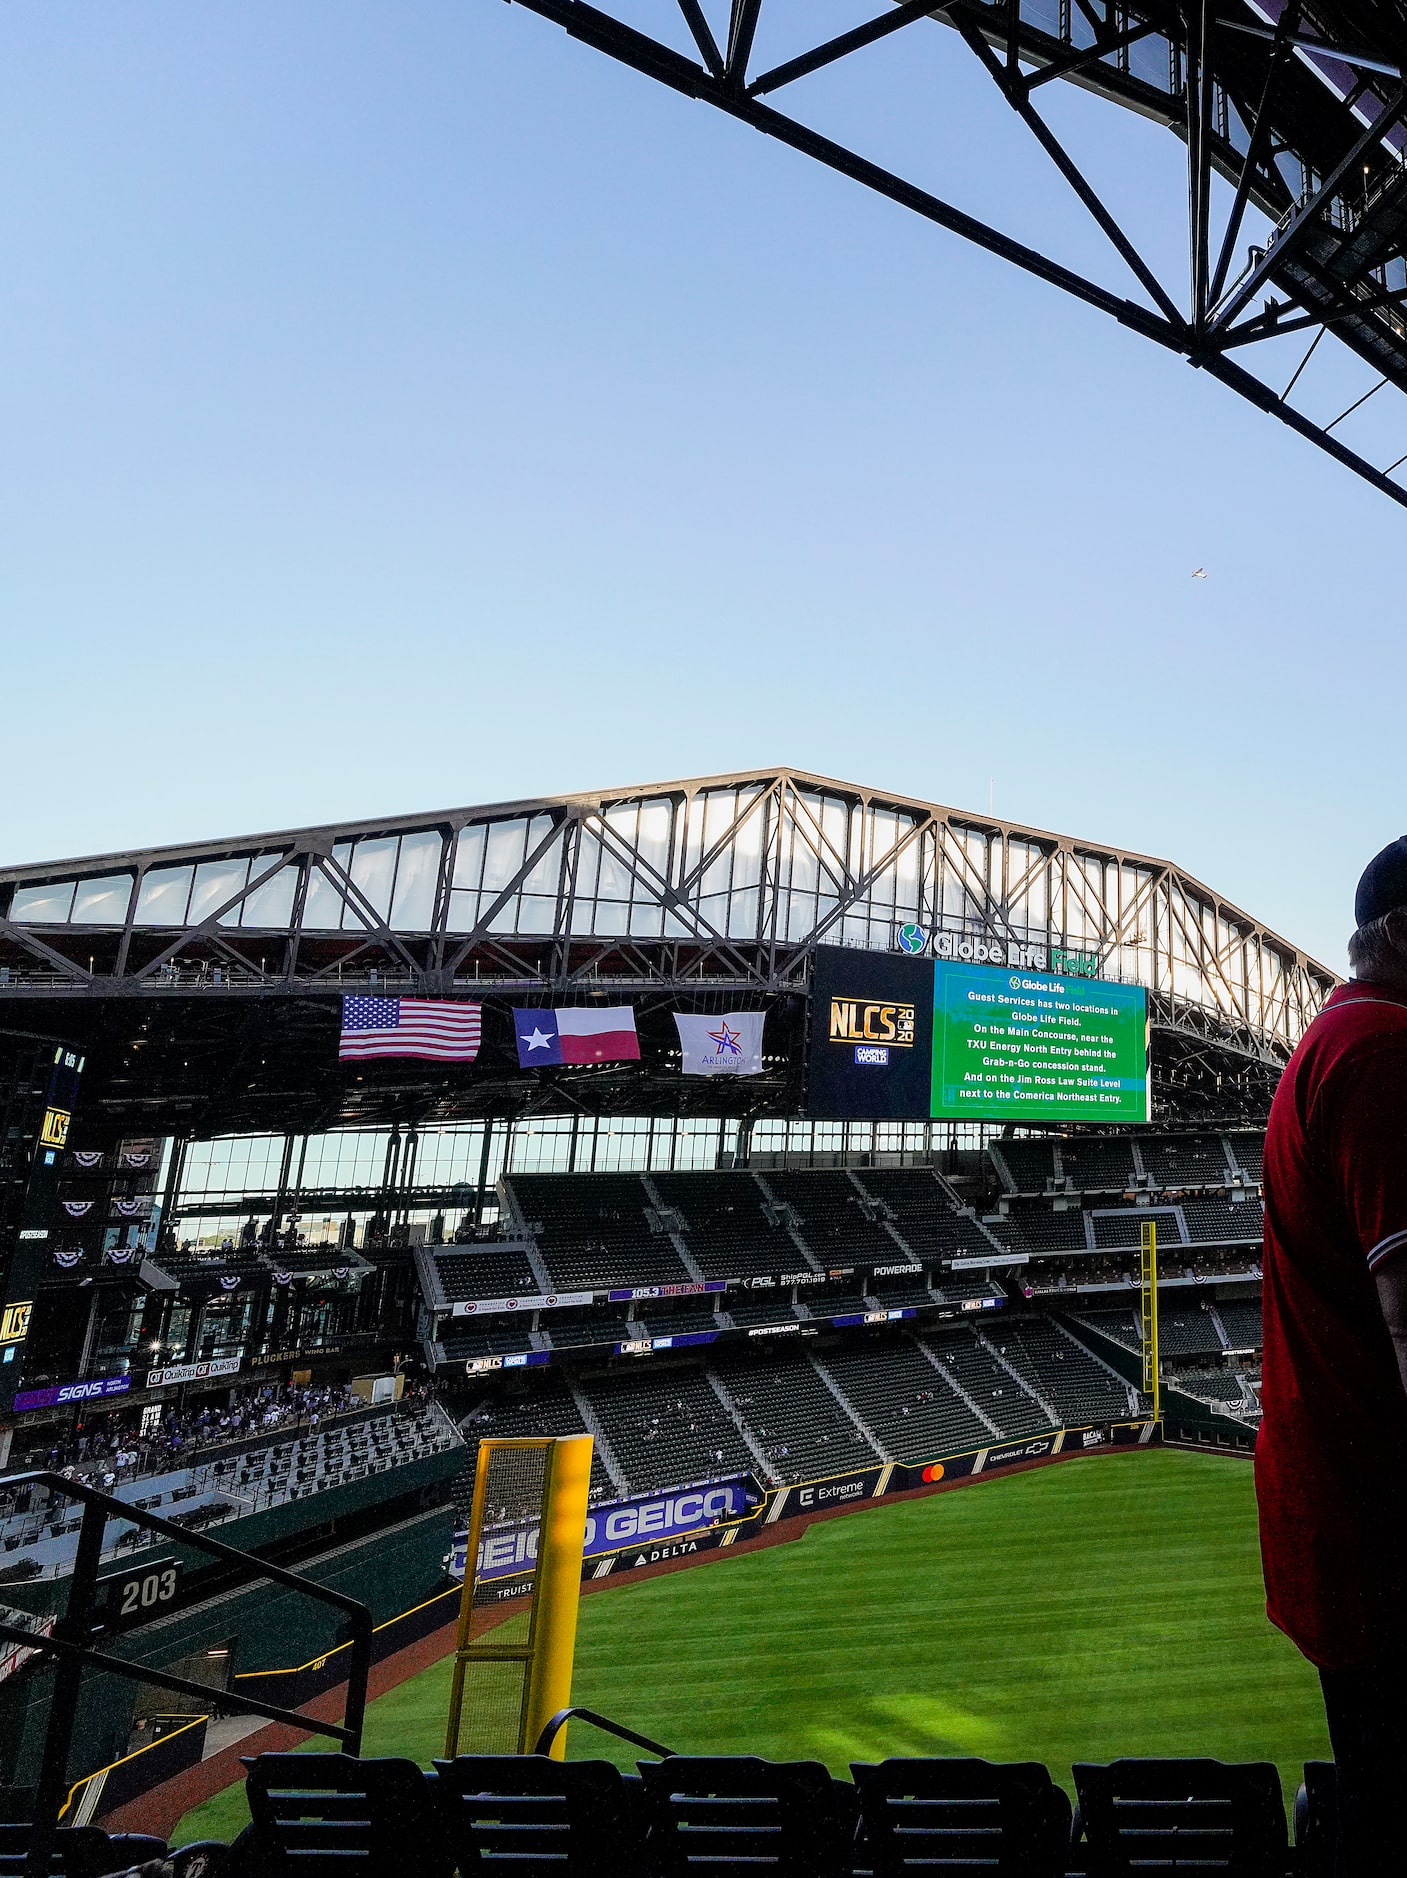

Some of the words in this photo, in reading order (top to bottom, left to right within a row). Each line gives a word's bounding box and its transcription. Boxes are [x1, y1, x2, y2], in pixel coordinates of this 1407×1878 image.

[933, 932, 1002, 963] Globe
[1007, 943, 1047, 969] Life
[1051, 949, 1097, 976] Field
[1022, 979, 1048, 992] Globe
[1049, 982, 1065, 993] Life
[968, 991, 995, 1003] Guest
[997, 994, 1035, 1007] Services
[1037, 999, 1053, 1009] has
[1054, 1001, 1070, 1011] two
[1072, 1003, 1109, 1015] locations
[1110, 1007, 1119, 1016] in
[830, 1002, 896, 1041] NLCS
[897, 1008, 914, 1020] 20
[1011, 1011, 1038, 1022] Globe
[1040, 1013, 1056, 1024] Life
[1058, 1016, 1082, 1026] Field.
[897, 1031, 914, 1042] 20
[973, 1024, 987, 1034] On
[990, 1025, 1005, 1035] the
[1007, 1027, 1029, 1037] Main
[1031, 1029, 1079, 1042] Concourse,
[1081, 1034, 1099, 1043] near
[1101, 1035, 1114, 1044] the
[857, 1048, 887, 1056] CAMPING
[967, 1039, 987, 1049] TXU
[989, 1041, 1021, 1053] Energy
[1023, 1044, 1048, 1054] North
[1050, 1046, 1072, 1056] Entry
[1074, 1047, 1101, 1058] behind
[1103, 1050, 1117, 1059] the
[702, 1055, 746, 1065] ARLINGTON
[857, 1054, 887, 1063] WORLD
[982, 1056, 1030, 1068] Grab-n-Go
[1032, 1059, 1079, 1071] concession
[1081, 1063, 1106, 1072] stand.
[964, 1072, 982, 1082] And
[1000, 1074, 1015, 1083] the
[1017, 1075, 1032, 1084] Jim
[1035, 1075, 1056, 1085] Ross
[1058, 1077, 1074, 1086] Law
[1076, 1077, 1098, 1087] Suite
[1100, 1078, 1121, 1088] Level
[960, 1089, 981, 1098] next
[983, 1090, 993, 1098] to
[996, 1089, 1011, 1099] the
[1013, 1090, 1055, 1100] Comerica
[1056, 1092, 1098, 1102] Northeast
[1099, 1094, 1122, 1104] Entry.
[41, 1111, 65, 1143] NLCS
[781, 1273, 826, 1281] ShipPGL.com
[873, 1263, 923, 1276] POWERADE
[751, 1276, 776, 1287] PGL
[631, 1287, 659, 1299] 105.3
[661, 1285, 681, 1296] THE
[683, 1283, 705, 1294] FAN
[0, 1306, 26, 1341] NLCS
[748, 1324, 800, 1336] #POSTSEASON
[251, 1350, 300, 1366] PLUCKERS
[150, 1371, 163, 1384] QT
[164, 1367, 195, 1380] QuikTrip
[196, 1364, 209, 1376] QT
[210, 1361, 239, 1374] QuikTrip
[57, 1381, 103, 1402] SIGNS
[143, 1404, 162, 1415] GRAND
[990, 1450, 1023, 1462] CHEVROLET
[818, 1482, 863, 1499] Extreme
[839, 1490, 863, 1501] networks
[605, 1487, 734, 1541] GEICO
[651, 1542, 698, 1562] DELTA
[120, 1569, 177, 1616] 203
[497, 1583, 533, 1598] TRUIST
[312, 1658, 326, 1671] 407
